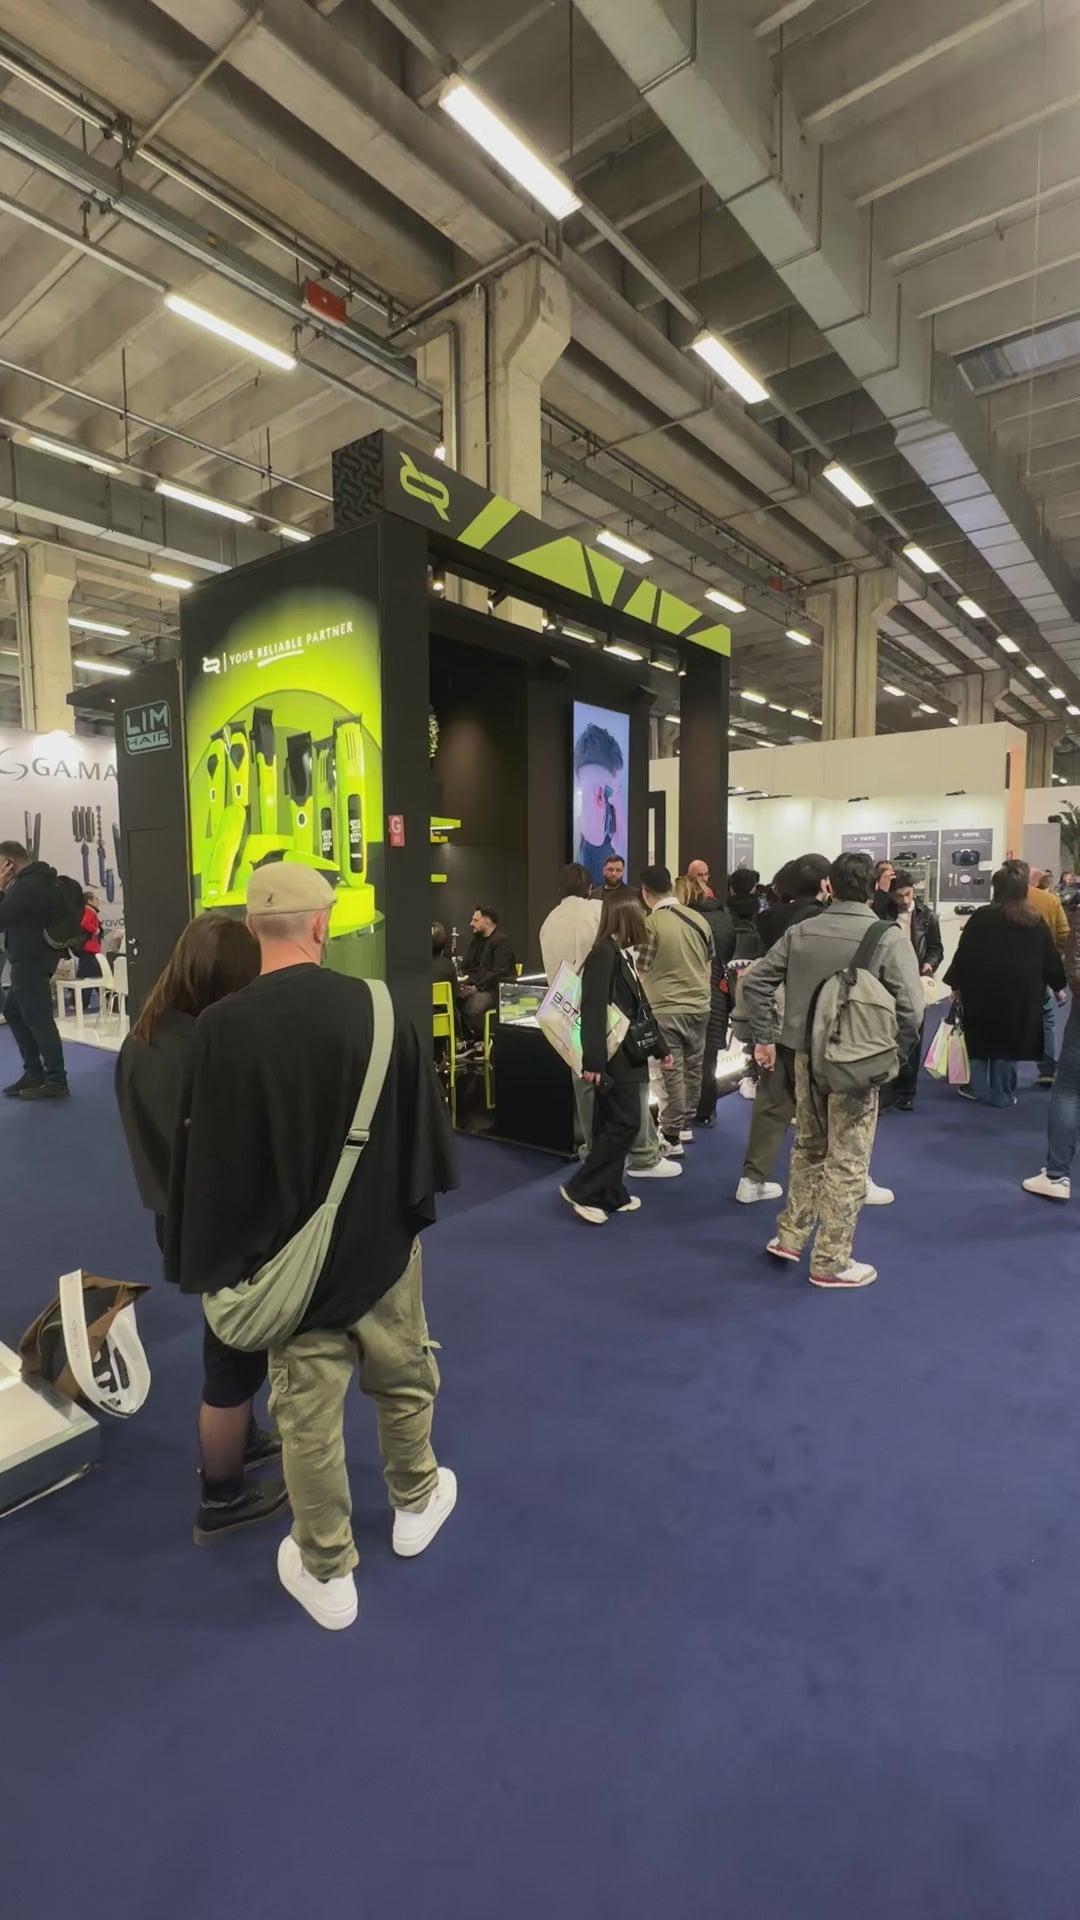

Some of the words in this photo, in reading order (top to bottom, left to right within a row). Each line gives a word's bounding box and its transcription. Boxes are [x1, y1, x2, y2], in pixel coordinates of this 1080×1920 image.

[230, 650, 254, 665] YOUR
[257, 636, 303, 658] RELIABLE
[306, 621, 354, 645] PARTNER
[126, 705, 169, 736] LIM
[32, 757, 118, 781] GA.MA
[391, 816, 402, 834] G
